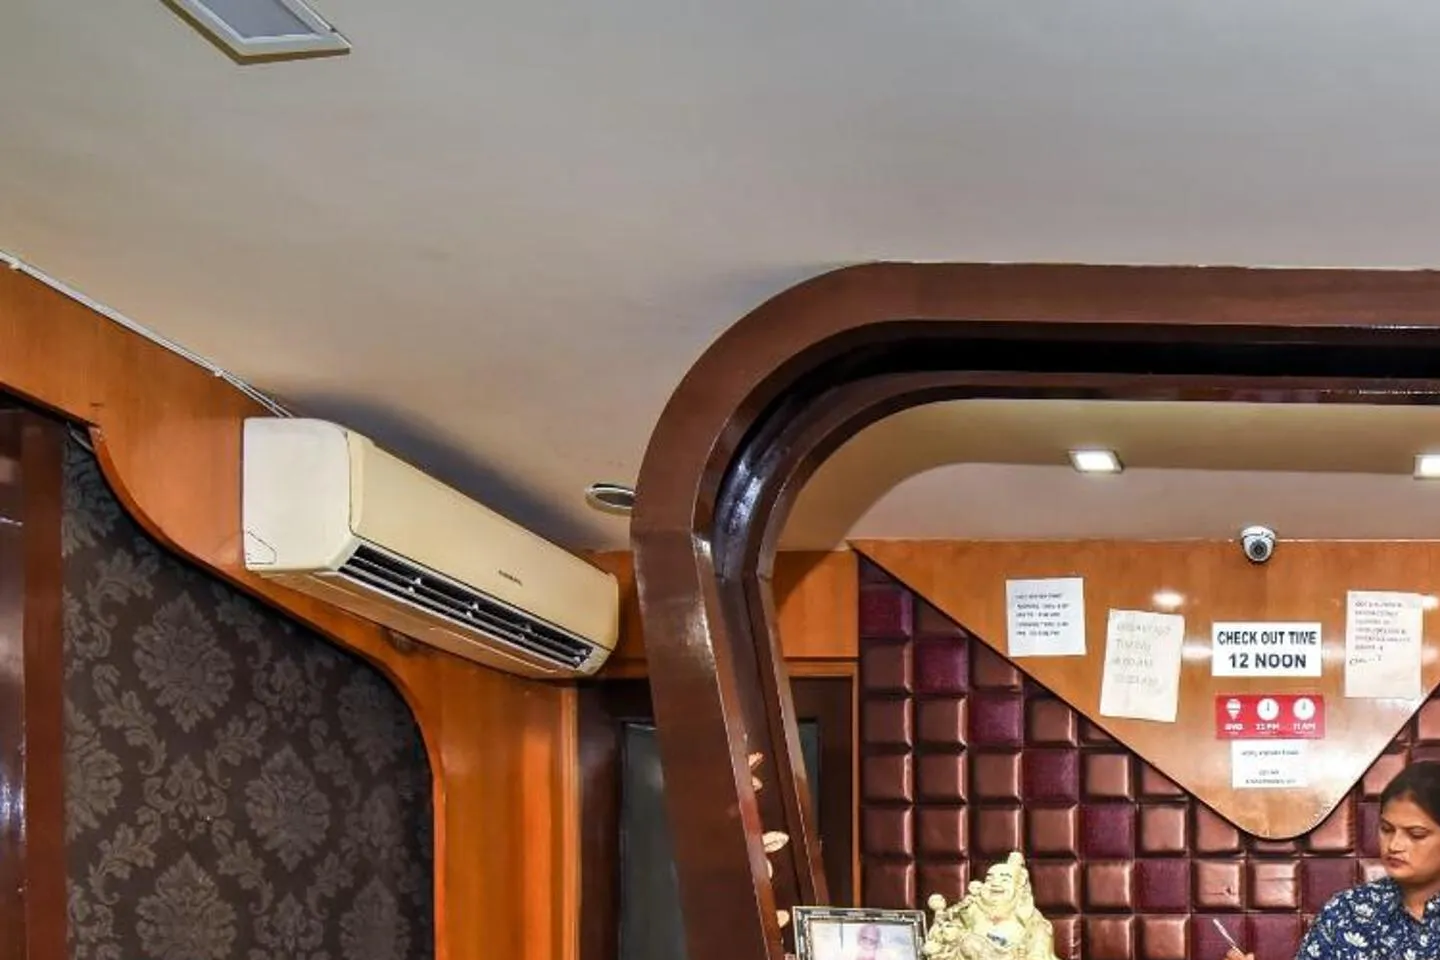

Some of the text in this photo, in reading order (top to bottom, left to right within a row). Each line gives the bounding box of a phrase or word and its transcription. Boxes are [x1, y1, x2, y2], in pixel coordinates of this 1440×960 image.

[1217, 631, 1317, 645] CHECK OUT TIME
[1229, 652, 1306, 668] 12 NOON
